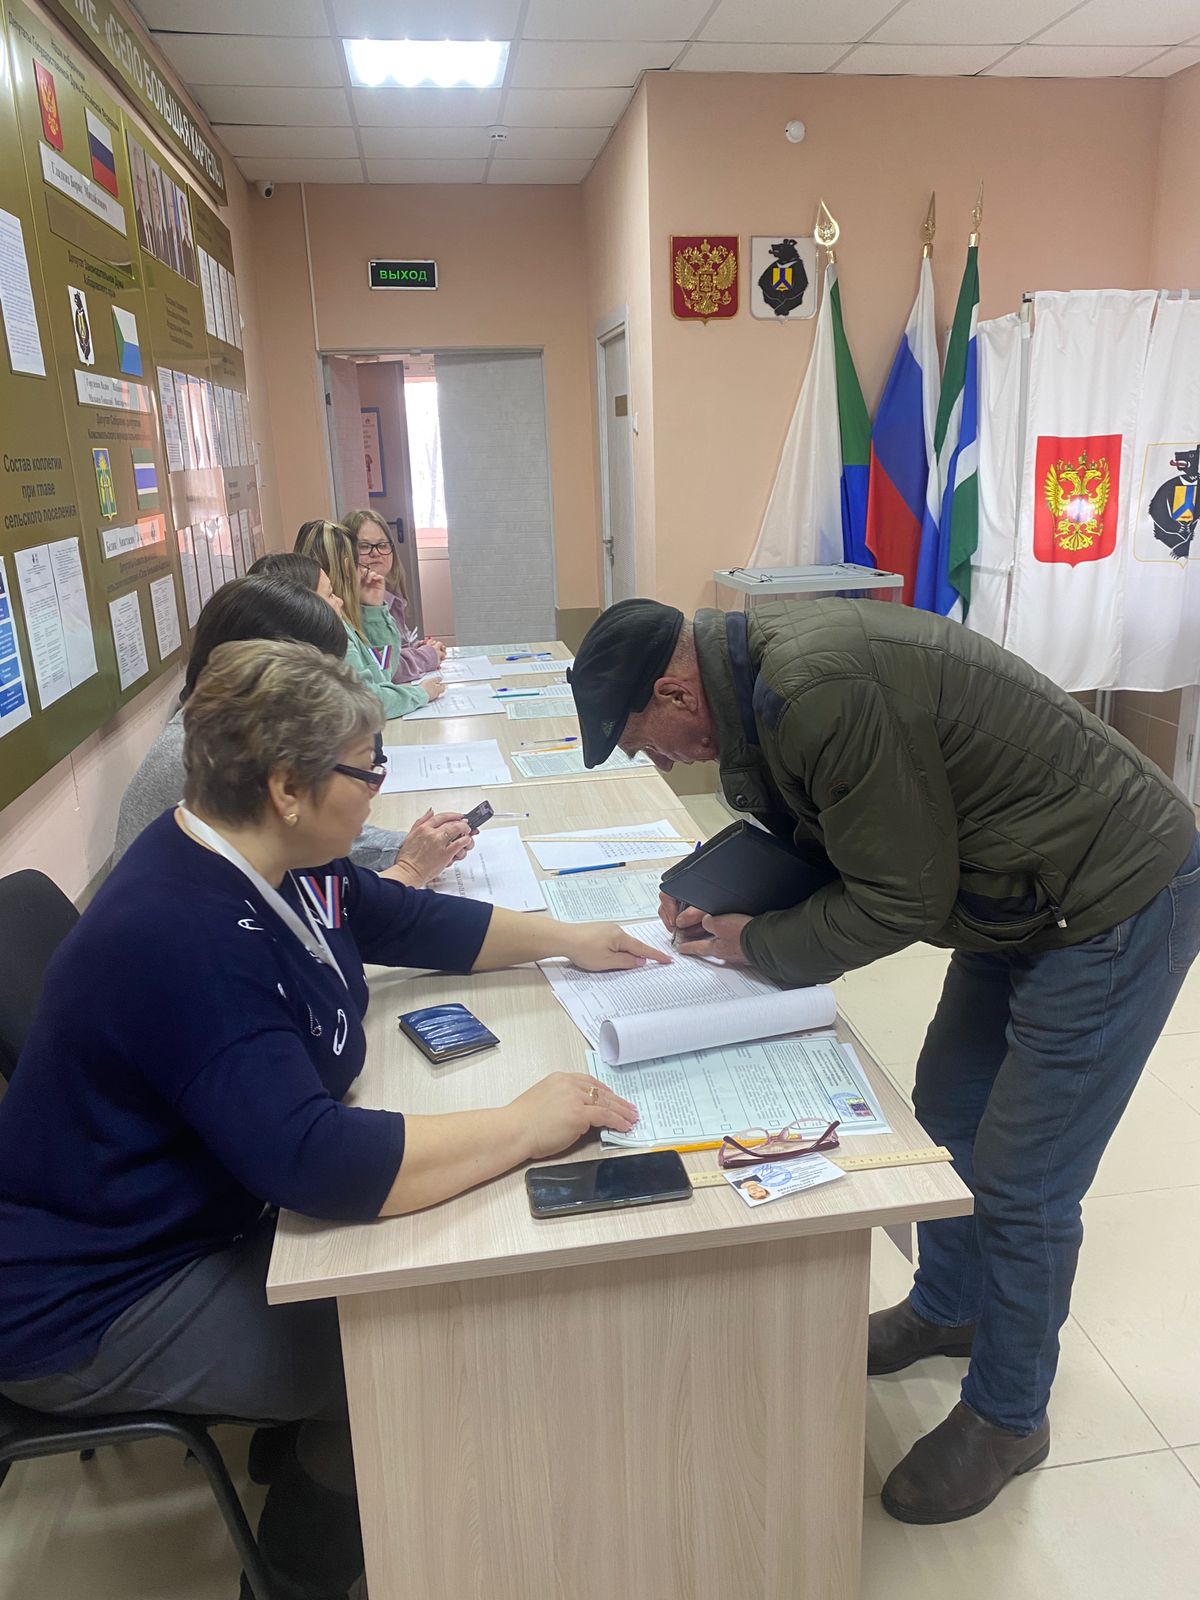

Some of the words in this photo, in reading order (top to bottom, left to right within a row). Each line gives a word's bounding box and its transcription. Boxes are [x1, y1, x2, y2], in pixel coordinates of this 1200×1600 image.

[143, 59, 189, 148] БОЛЬШАЯ
[379, 270, 428, 283] ВЫХОД
[3, 454, 31, 473] Состав
[21, 484, 36, 503] при
[36, 482, 56, 497] главе
[4, 509, 43, 529] сельского
[42, 504, 77, 522] поселения
